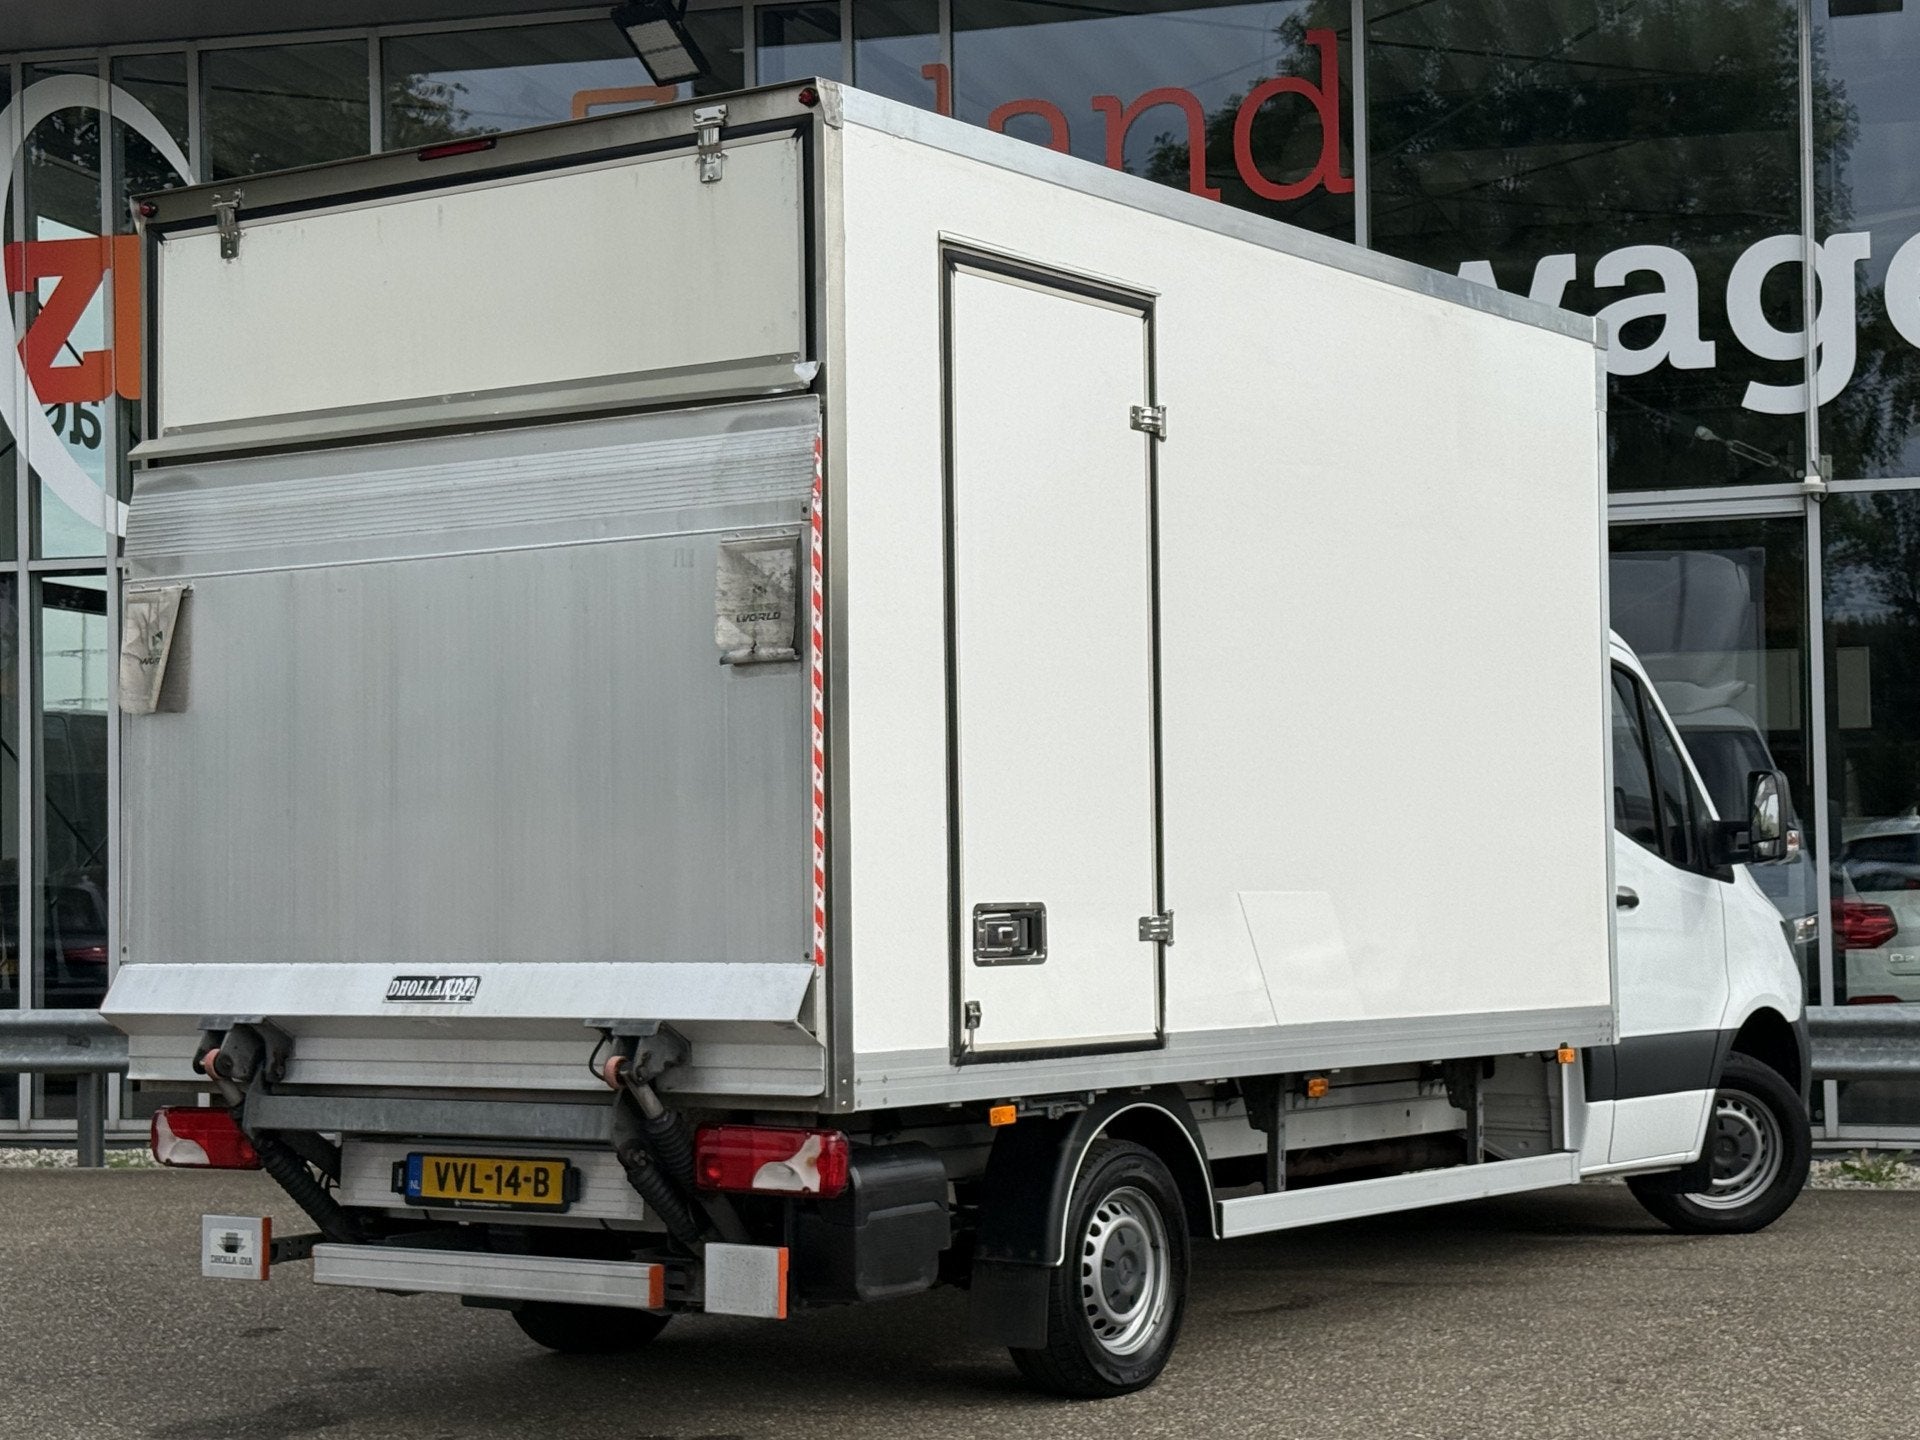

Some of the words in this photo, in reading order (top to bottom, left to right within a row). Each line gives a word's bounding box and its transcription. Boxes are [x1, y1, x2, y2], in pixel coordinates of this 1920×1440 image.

[1457, 231, 1920, 415] ag
[736, 611, 781, 623] WORLD
[410, 1179, 421, 1190] NL
[434, 1161, 550, 1198] VVL-14-B
